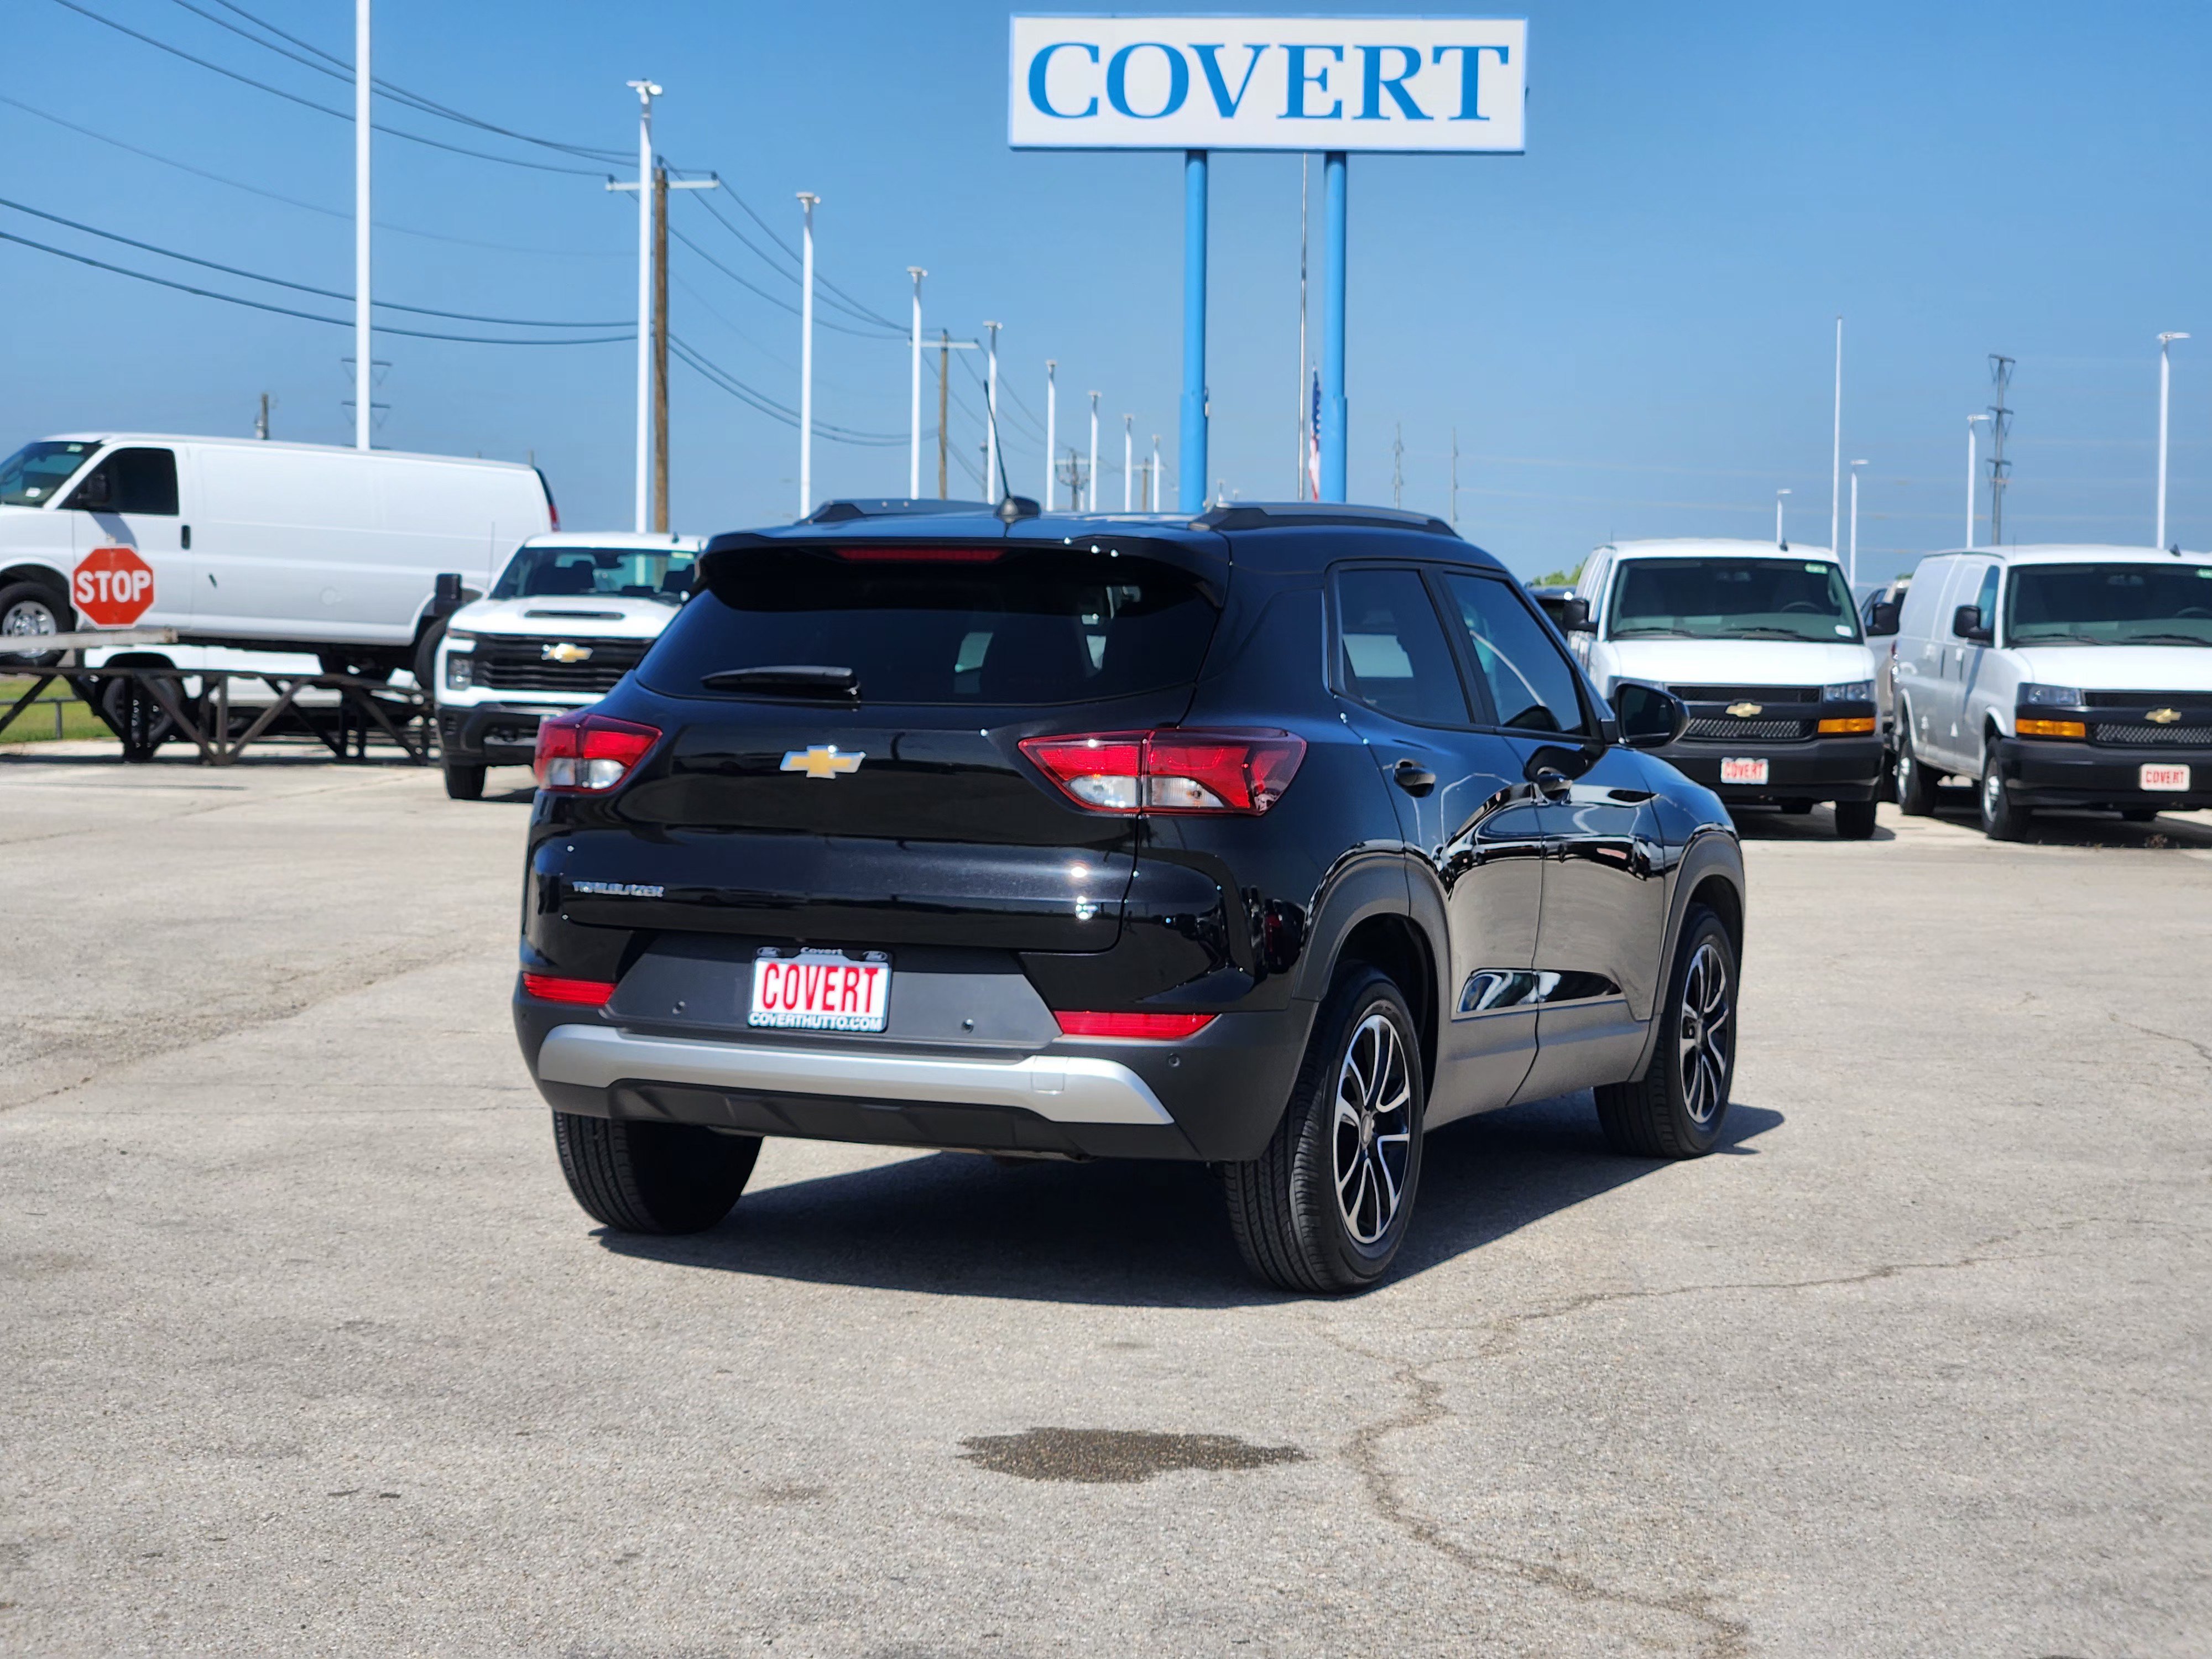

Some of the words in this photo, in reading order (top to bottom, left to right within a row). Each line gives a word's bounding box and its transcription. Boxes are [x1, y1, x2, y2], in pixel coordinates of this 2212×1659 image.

[1028, 42, 1509, 121] COVERT
[76, 570, 152, 603] STOP
[1724, 763, 1764, 780] COVERT
[2146, 770, 2184, 784] COVERT
[762, 963, 879, 1013] COVERT
[748, 1013, 883, 1032] COVERTHUTTO.COM
